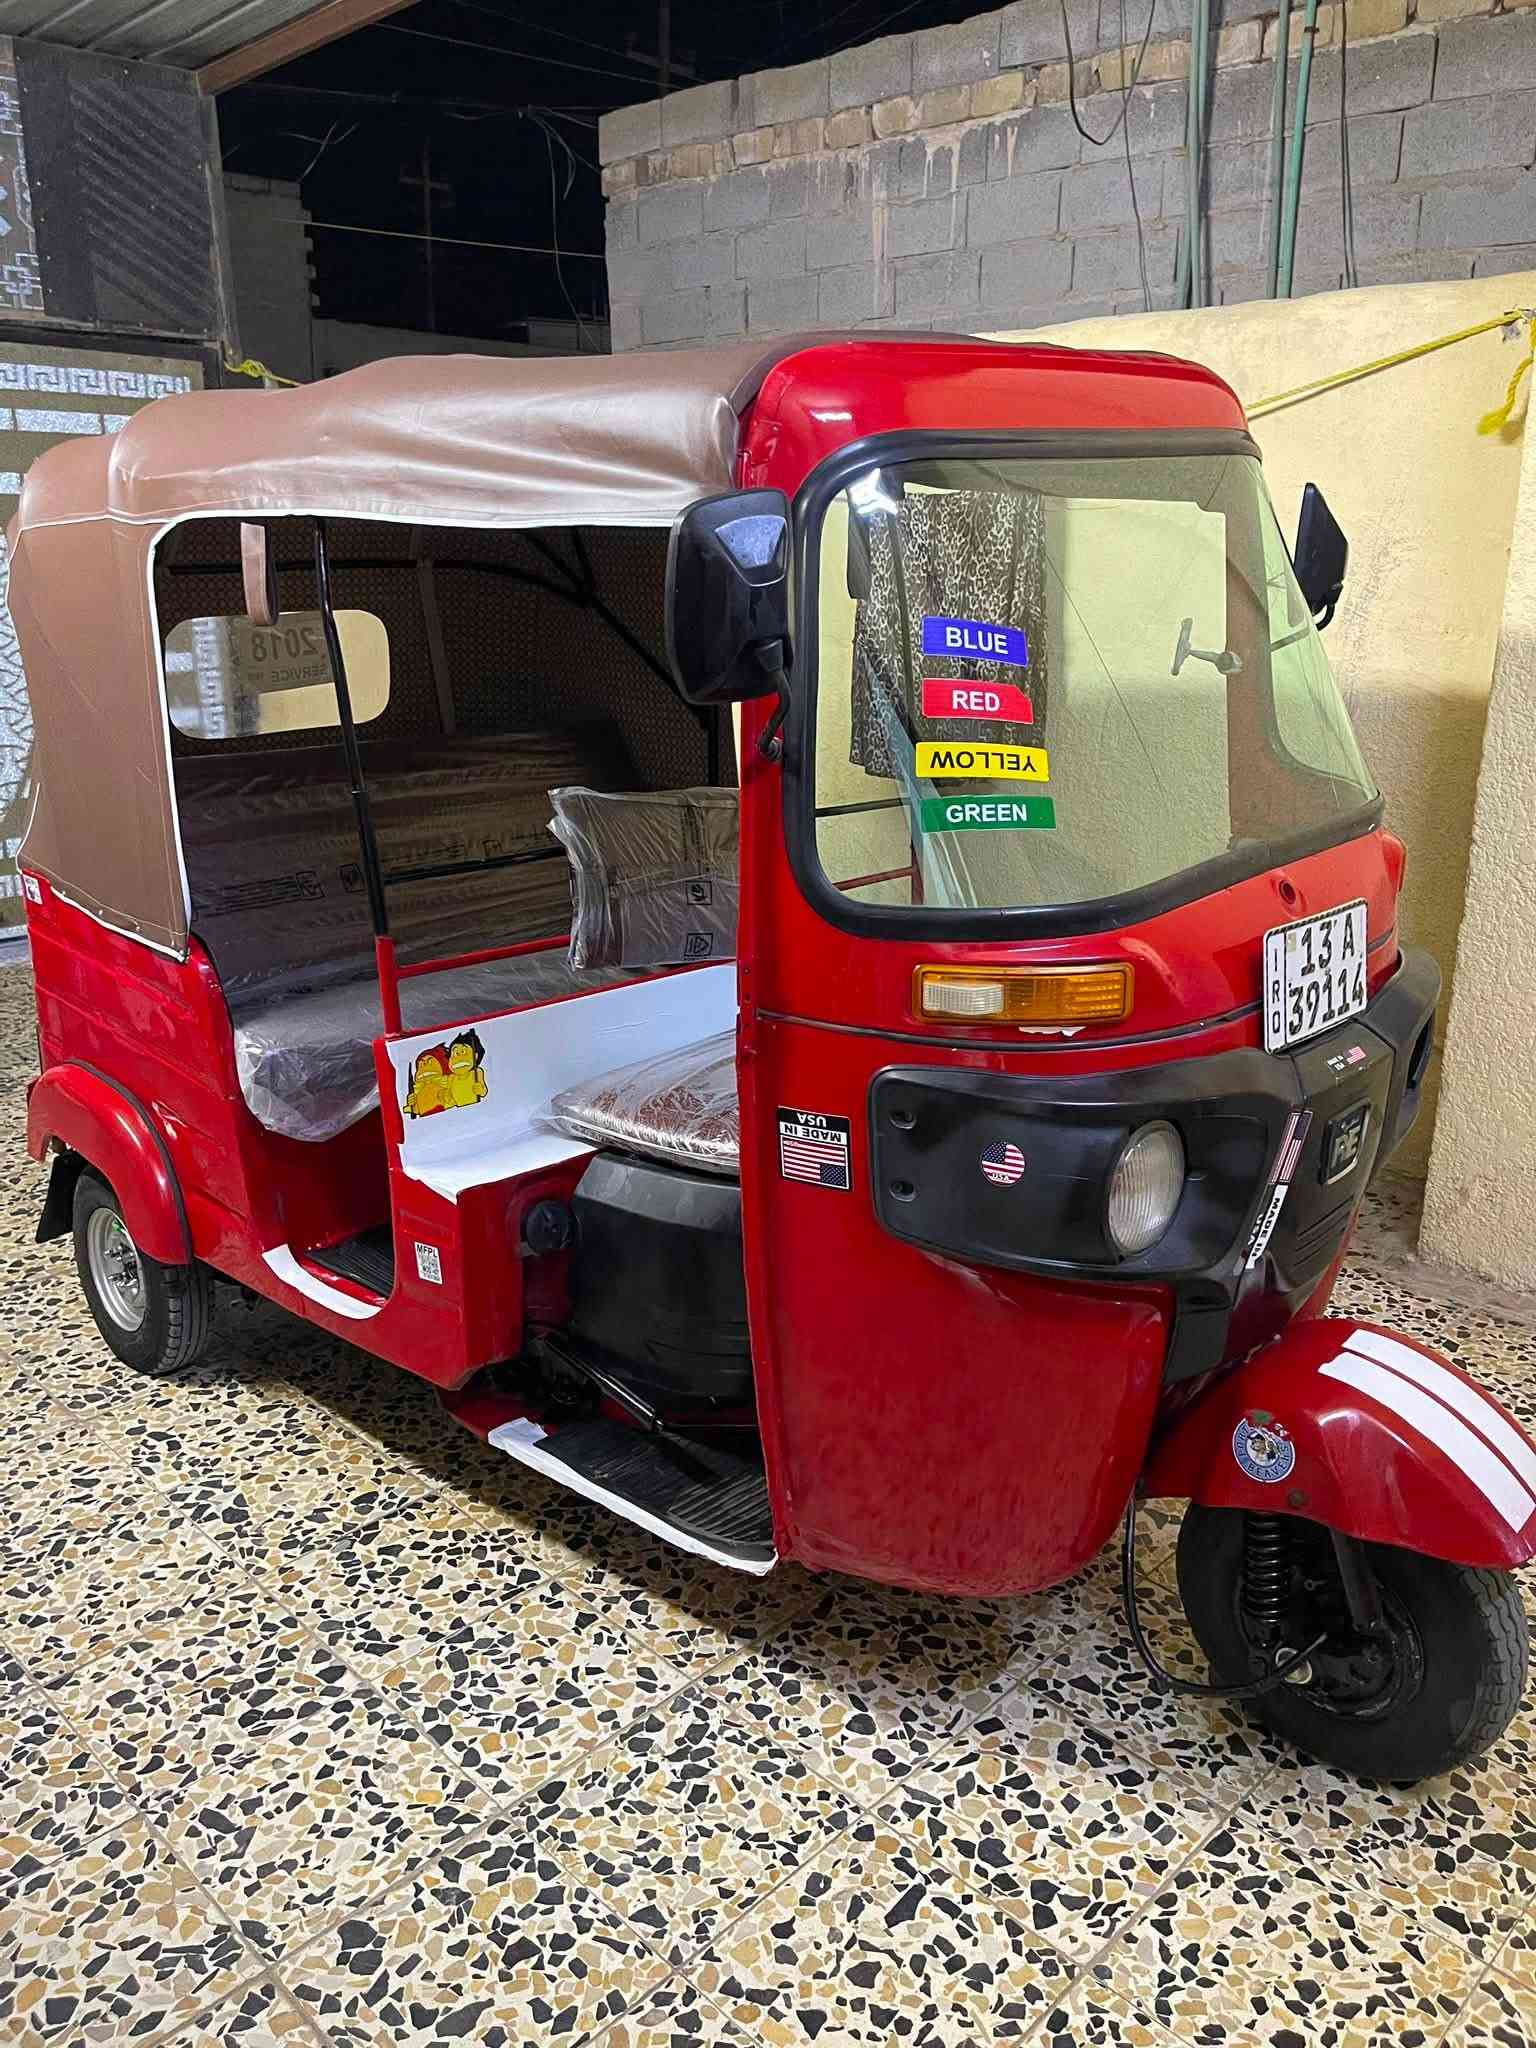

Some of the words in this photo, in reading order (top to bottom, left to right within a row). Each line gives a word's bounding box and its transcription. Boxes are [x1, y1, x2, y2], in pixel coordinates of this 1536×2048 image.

[945, 626, 1009, 655] BLUE
[952, 690, 1000, 712] RED
[930, 751, 1038, 773] YELLOW
[946, 803, 1027, 824] GREEN
[1301, 918, 1333, 977] 13
[1341, 912, 1355, 961] A
[1288, 961, 1364, 1036] 39114
[784, 1124, 799, 1136] IN
[796, 1112, 828, 1128] USA
[801, 1127, 842, 1142] MADE
[991, 1172, 1010, 1182] USA
[1247, 1213, 1265, 1246] USA
[1260, 1197, 1280, 1240] MADE
